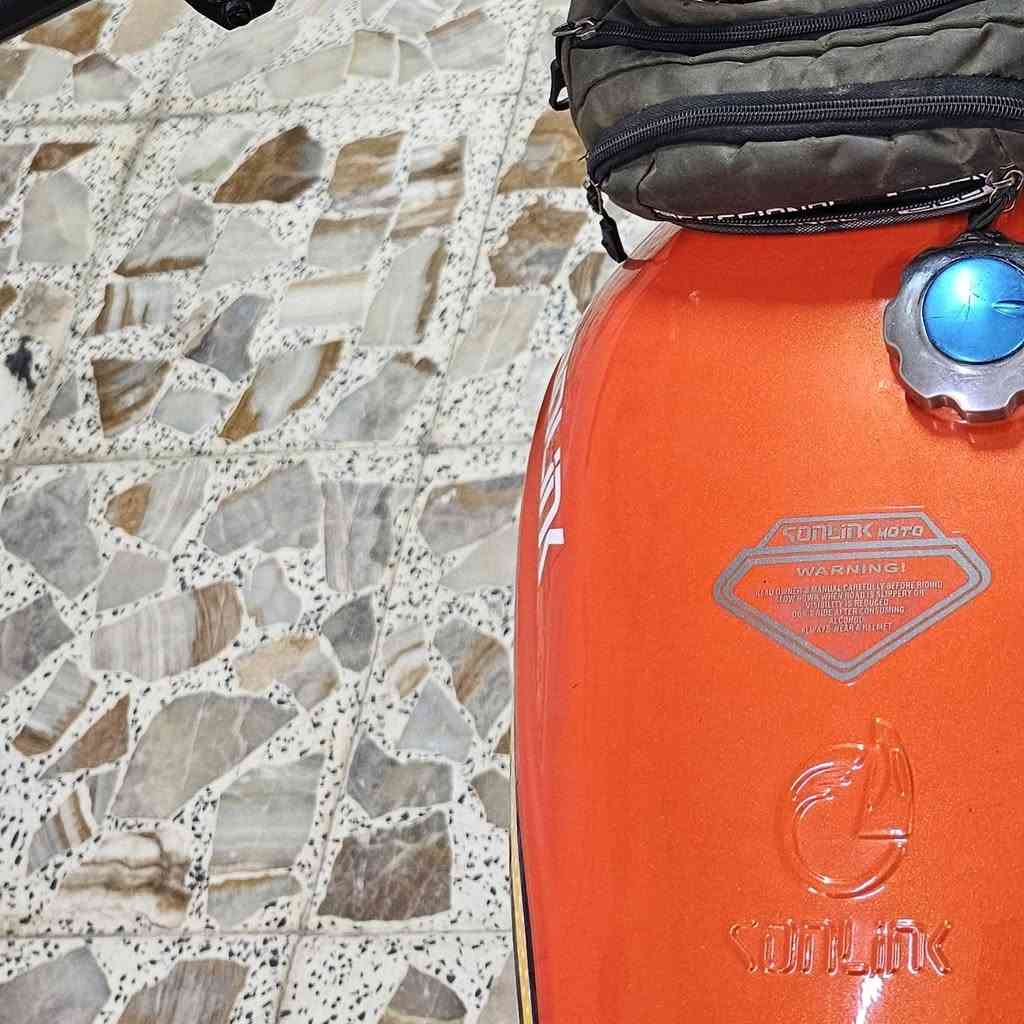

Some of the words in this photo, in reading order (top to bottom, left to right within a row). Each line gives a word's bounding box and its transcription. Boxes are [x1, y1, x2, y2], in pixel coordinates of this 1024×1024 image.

[878, 525, 924, 538] MOTO
[796, 562, 906, 577] WARNING!
[843, 582, 886, 592] CAREFULLY
[887, 580, 916, 590] BEFORE
[876, 588, 913, 598] SLIPPERY
[854, 597, 889, 607] REDUCED
[859, 605, 905, 615] CONSUMING
